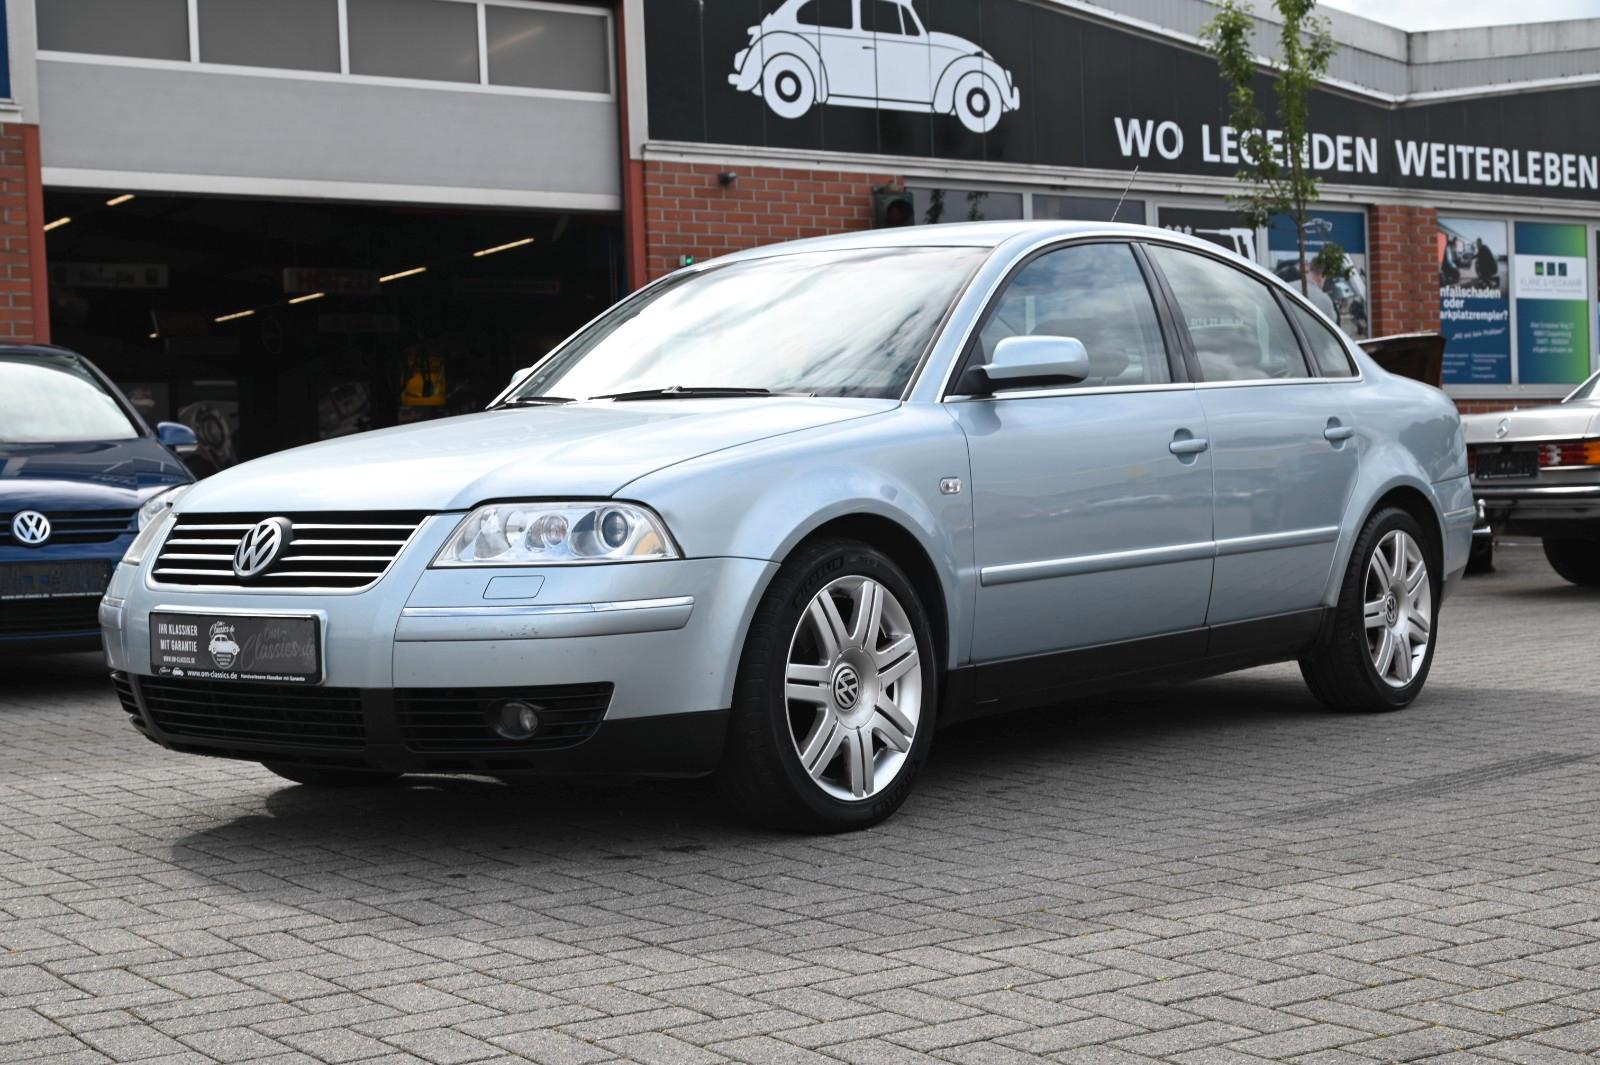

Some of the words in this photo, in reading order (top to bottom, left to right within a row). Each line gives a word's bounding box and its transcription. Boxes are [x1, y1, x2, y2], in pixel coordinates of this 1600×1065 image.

[1114, 117, 1184, 160] WO
[1395, 139, 1599, 189] WEITERLEBEN
[1440, 285, 1501, 298] nfallschaden
[1443, 298, 1465, 309] oder
[1440, 310, 1508, 322] arkplatzrempler?
[13, 510, 51, 544] VW
[233, 517, 282, 577] VW
[158, 623, 168, 634] IHR
[168, 624, 198, 636] KLASSIKER
[160, 639, 170, 650] MIT
[171, 640, 197, 652] GARANTIE
[834, 667, 859, 710] VW
